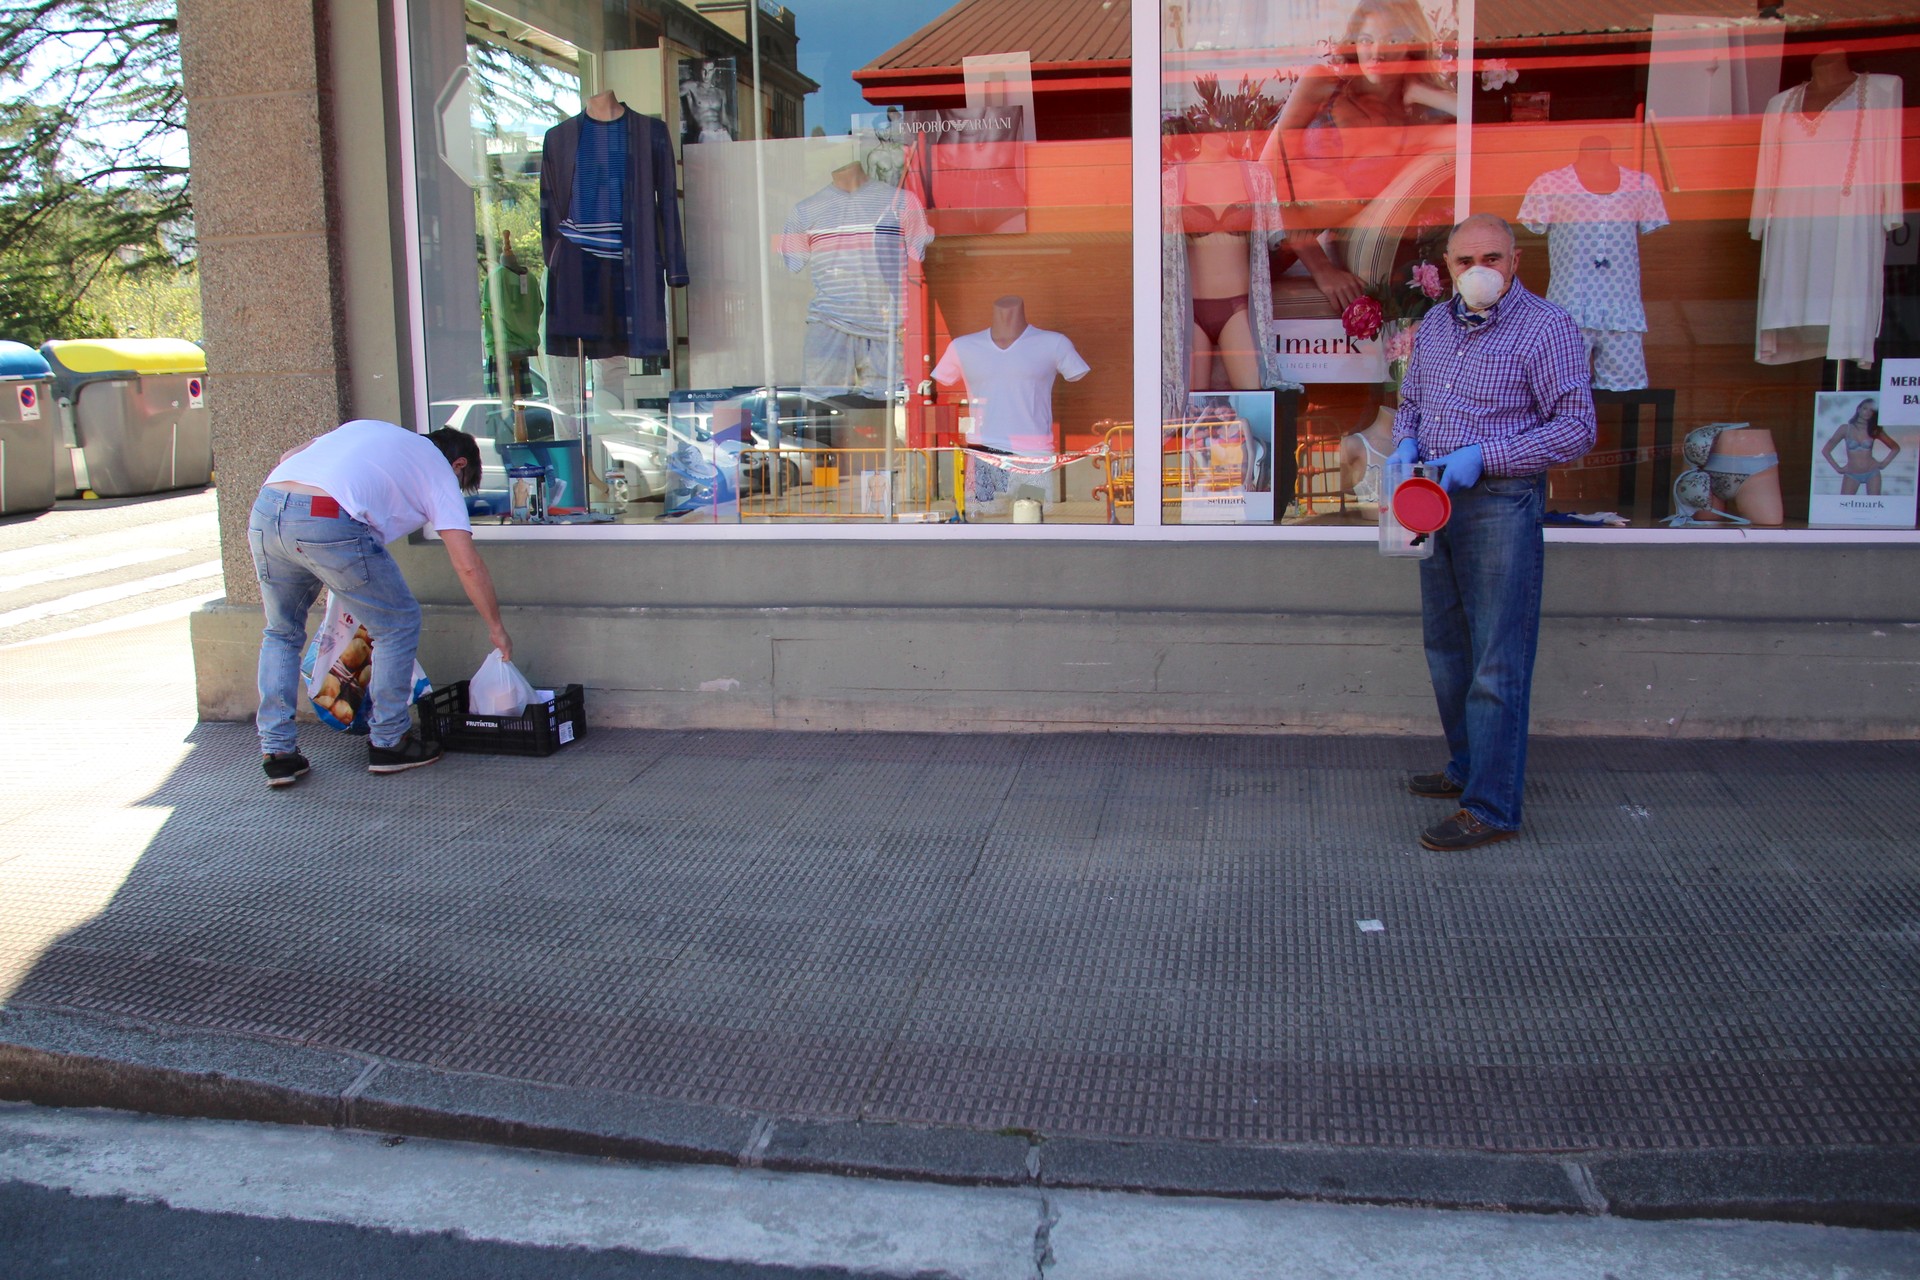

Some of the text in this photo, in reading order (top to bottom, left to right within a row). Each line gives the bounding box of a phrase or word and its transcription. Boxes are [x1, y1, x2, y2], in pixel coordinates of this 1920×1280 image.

[899, 117, 1011, 134] EMPORIO ARMANI
[1276, 334, 1361, 354] lmark
[1890, 376, 1920, 386] MER
[1903, 395, 1920, 404] BA
[1840, 500, 1884, 508] selmark
